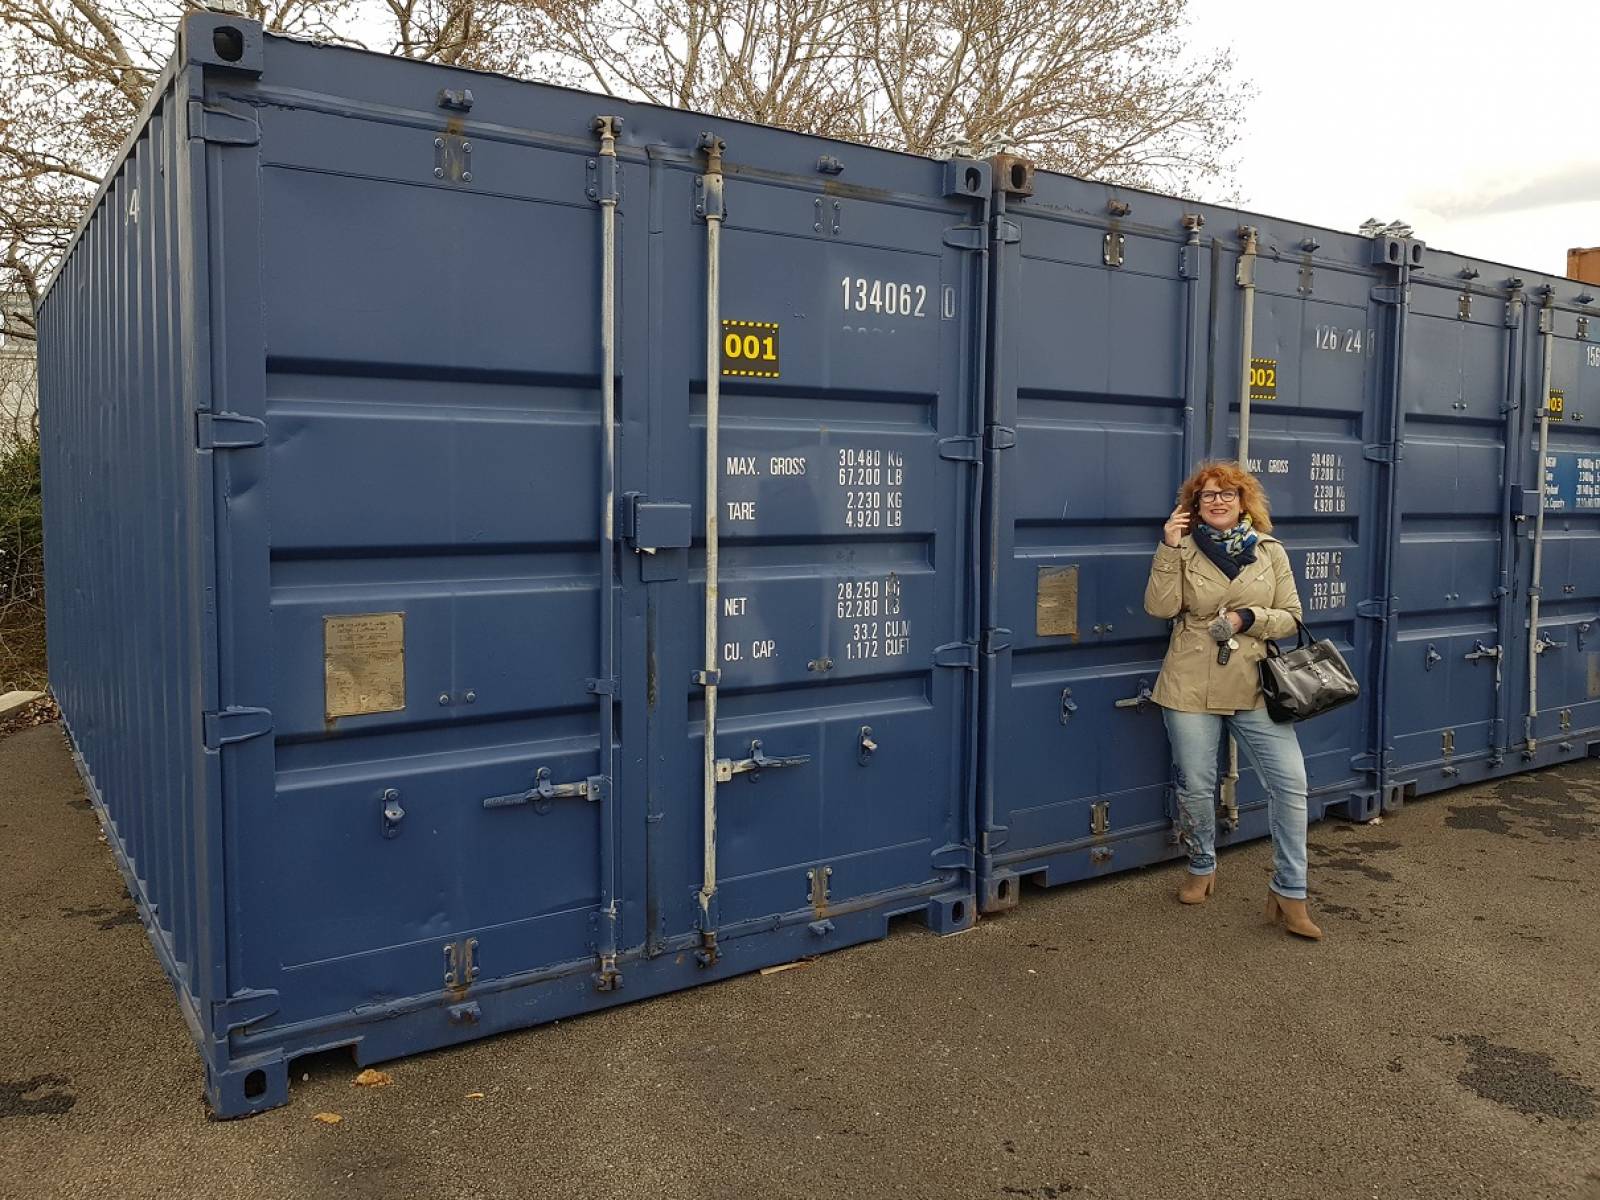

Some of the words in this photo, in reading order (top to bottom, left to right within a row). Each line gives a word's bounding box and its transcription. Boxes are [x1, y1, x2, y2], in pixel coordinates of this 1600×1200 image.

[841, 276, 927, 317] 134062
[725, 333, 777, 361] 001
[1547, 397, 1563, 412] 03
[726, 456, 760, 476] MAX.
[770, 456, 806, 476] GROSS
[839, 448, 880, 467] 30.480
[888, 449, 903, 467] KG
[1267, 459, 1289, 473] GROSS
[839, 467, 880, 486] 67.200
[887, 468, 903, 486] LB
[847, 491, 880, 509] 2.230
[887, 491, 903, 509] KG
[1314, 484, 1334, 498] 2.230
[727, 502, 756, 521] TARE
[1313, 499, 1334, 513] 4.920
[1336, 499, 1346, 512] LB
[845, 510, 880, 528] 4.920
[886, 510, 902, 527] LB
[837, 581, 879, 600] 28.250
[724, 597, 747, 616] NET
[837, 599, 878, 618] 62.280
[1309, 596, 1328, 611] 1.172
[853, 622, 878, 641] 33.2
[724, 641, 744, 661] CU.
[752, 639, 779, 659] CAP.
[846, 640, 878, 660] 1.172
